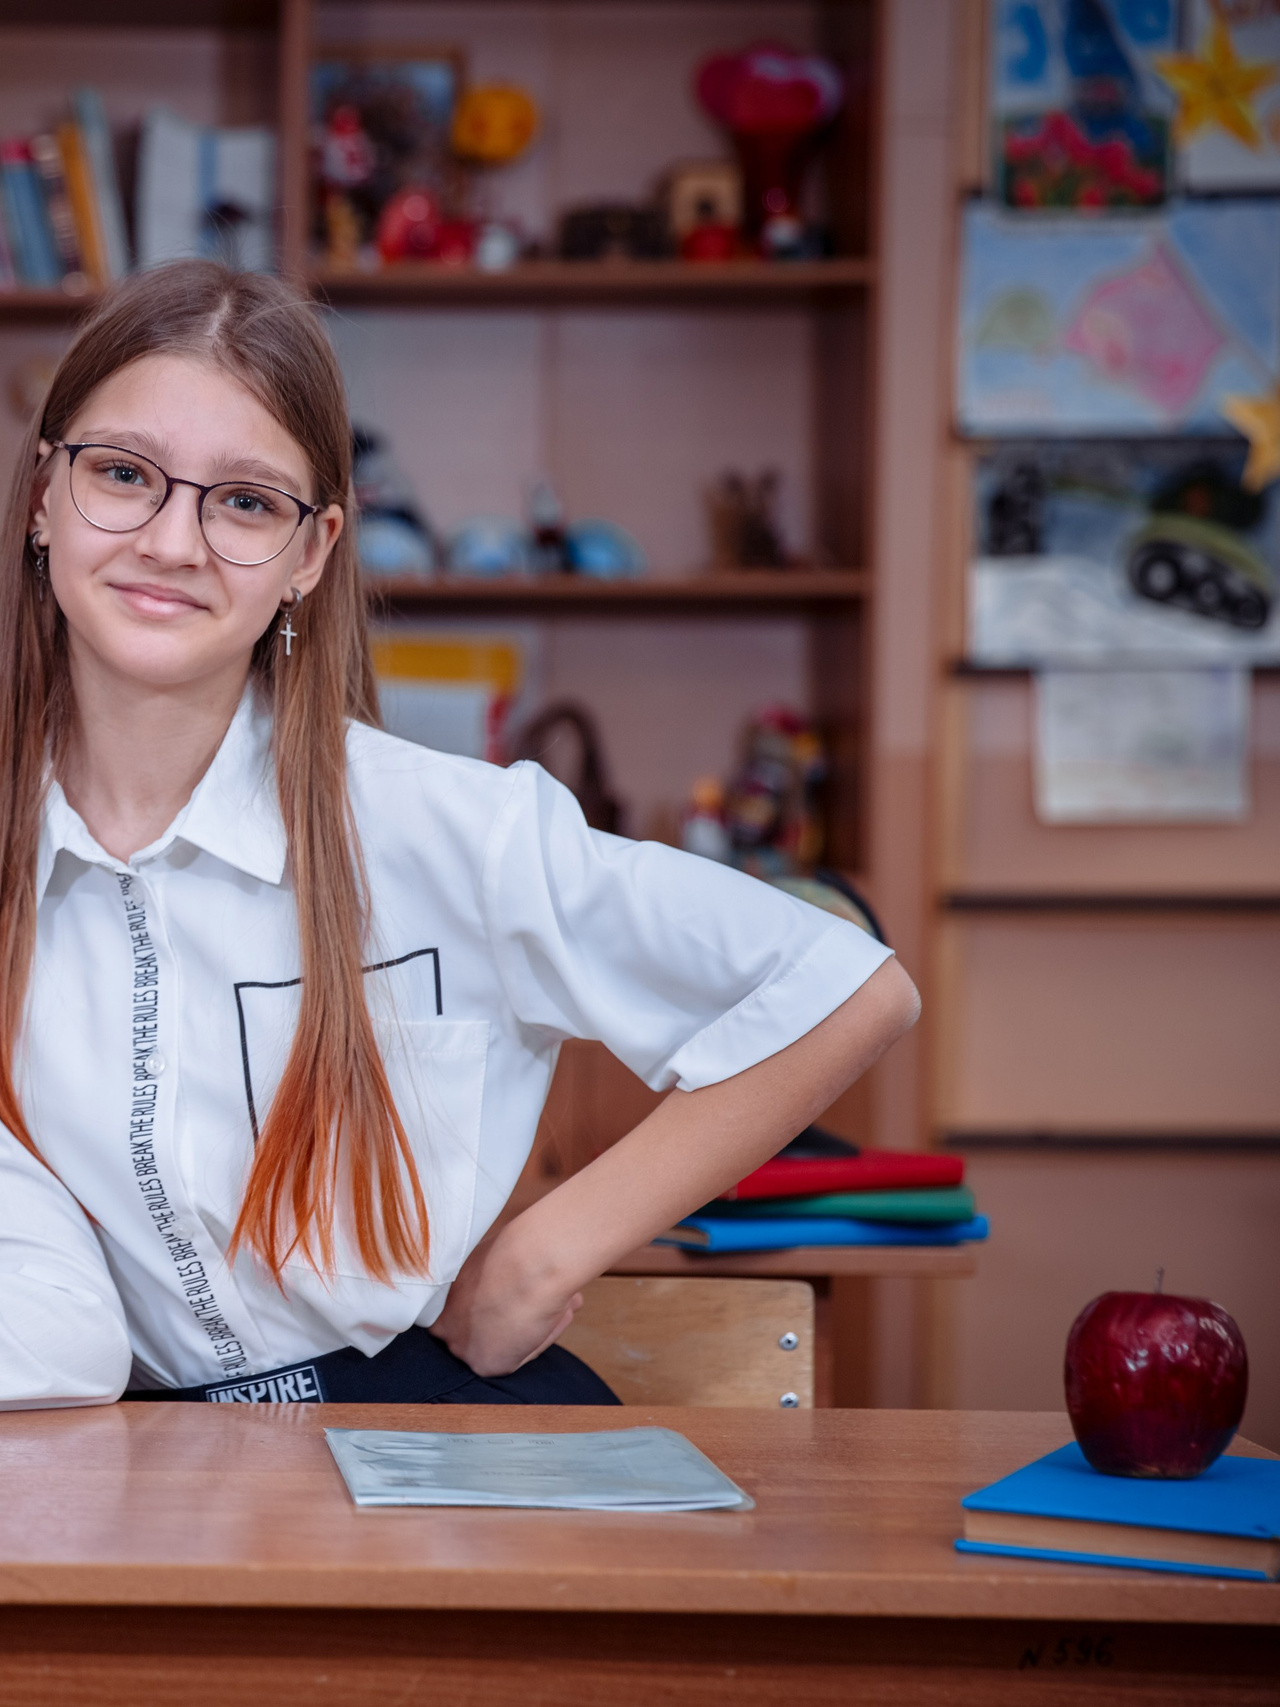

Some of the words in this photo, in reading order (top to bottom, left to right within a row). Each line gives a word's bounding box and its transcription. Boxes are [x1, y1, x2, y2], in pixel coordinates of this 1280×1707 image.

[130, 931, 154, 955] THE
[133, 952, 159, 989] BREAK
[132, 989, 158, 1023] RULES
[132, 1023, 158, 1047] THE
[131, 1083, 158, 1117] RULES
[129, 1117, 154, 1141] THE
[130, 1139, 158, 1177] BREAK
[138, 1178, 171, 1211] RULES
[177, 1260, 212, 1297] RULES
[189, 1294, 220, 1318] THE
